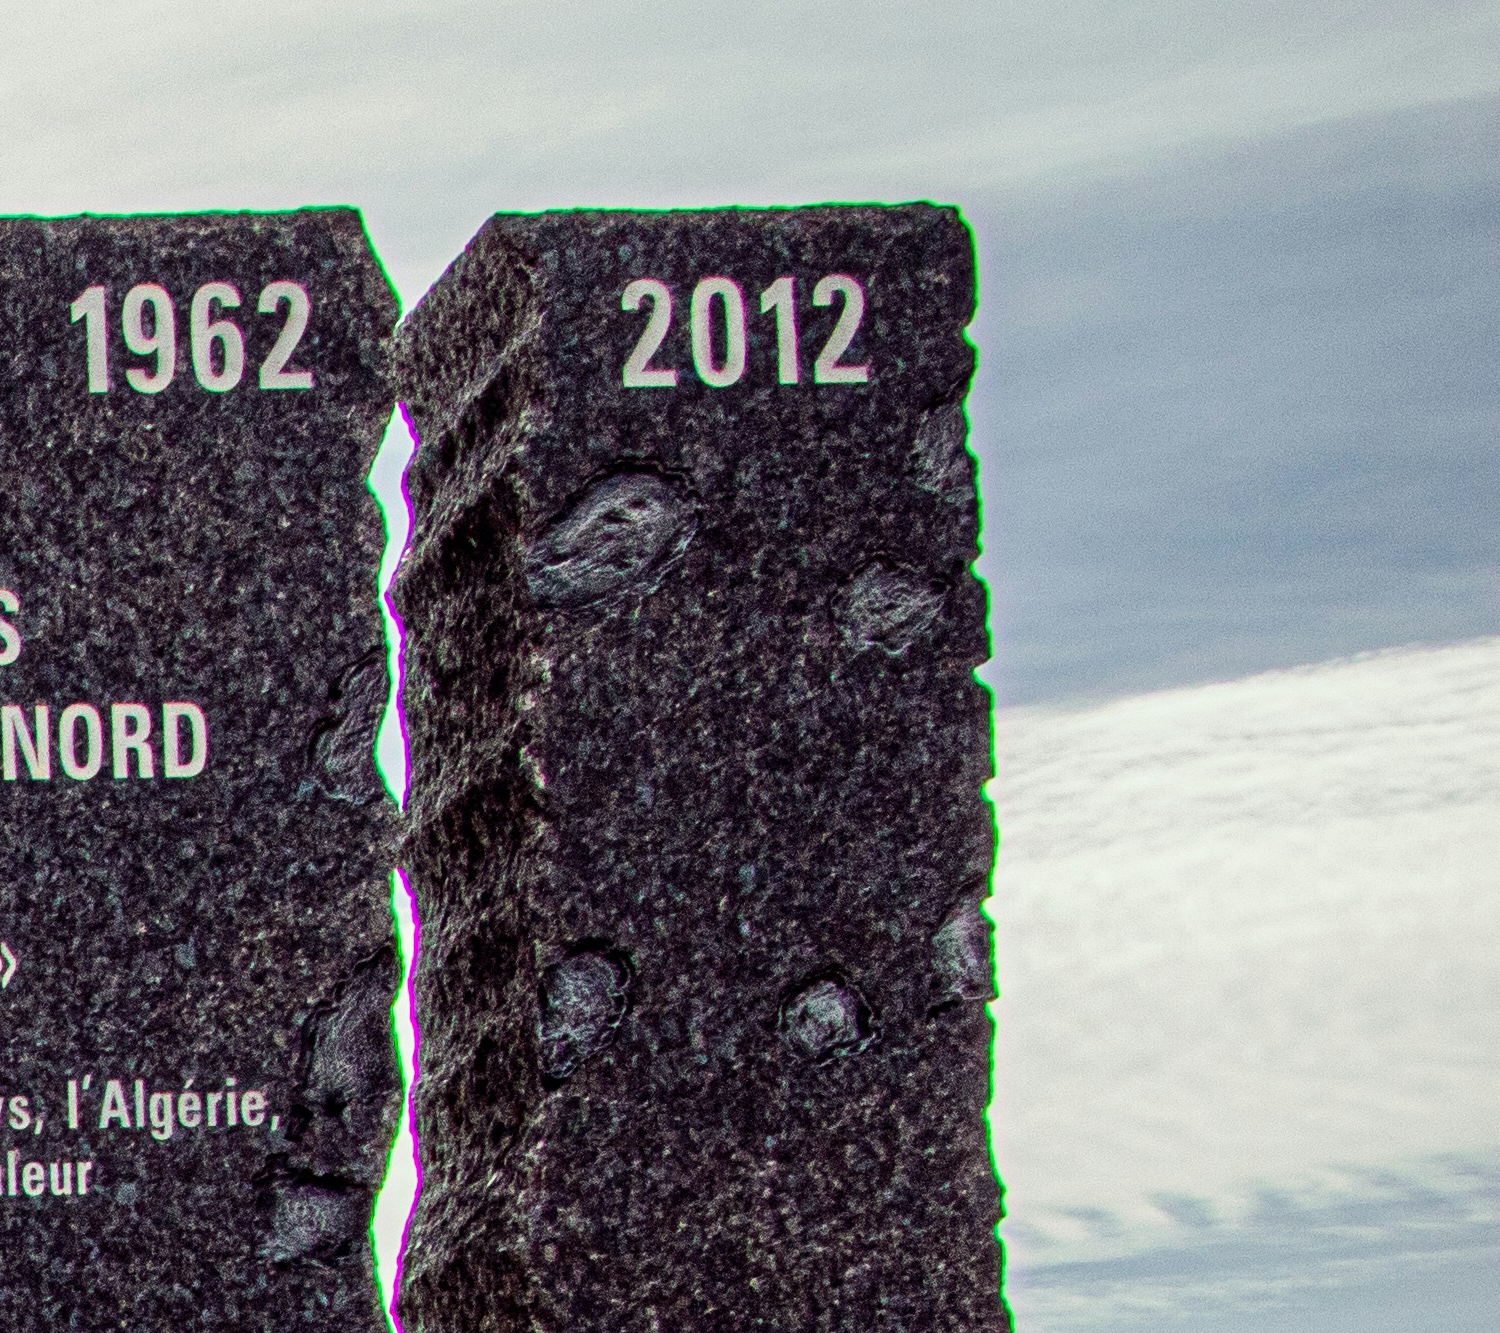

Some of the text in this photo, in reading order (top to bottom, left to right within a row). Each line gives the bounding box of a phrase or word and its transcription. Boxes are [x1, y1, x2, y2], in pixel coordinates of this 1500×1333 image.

[71, 281, 314, 394] 1962
[622, 275, 868, 387] 2012
[1, 702, 207, 781] NORD
[66, 1073, 281, 1141] l'Algérie,
